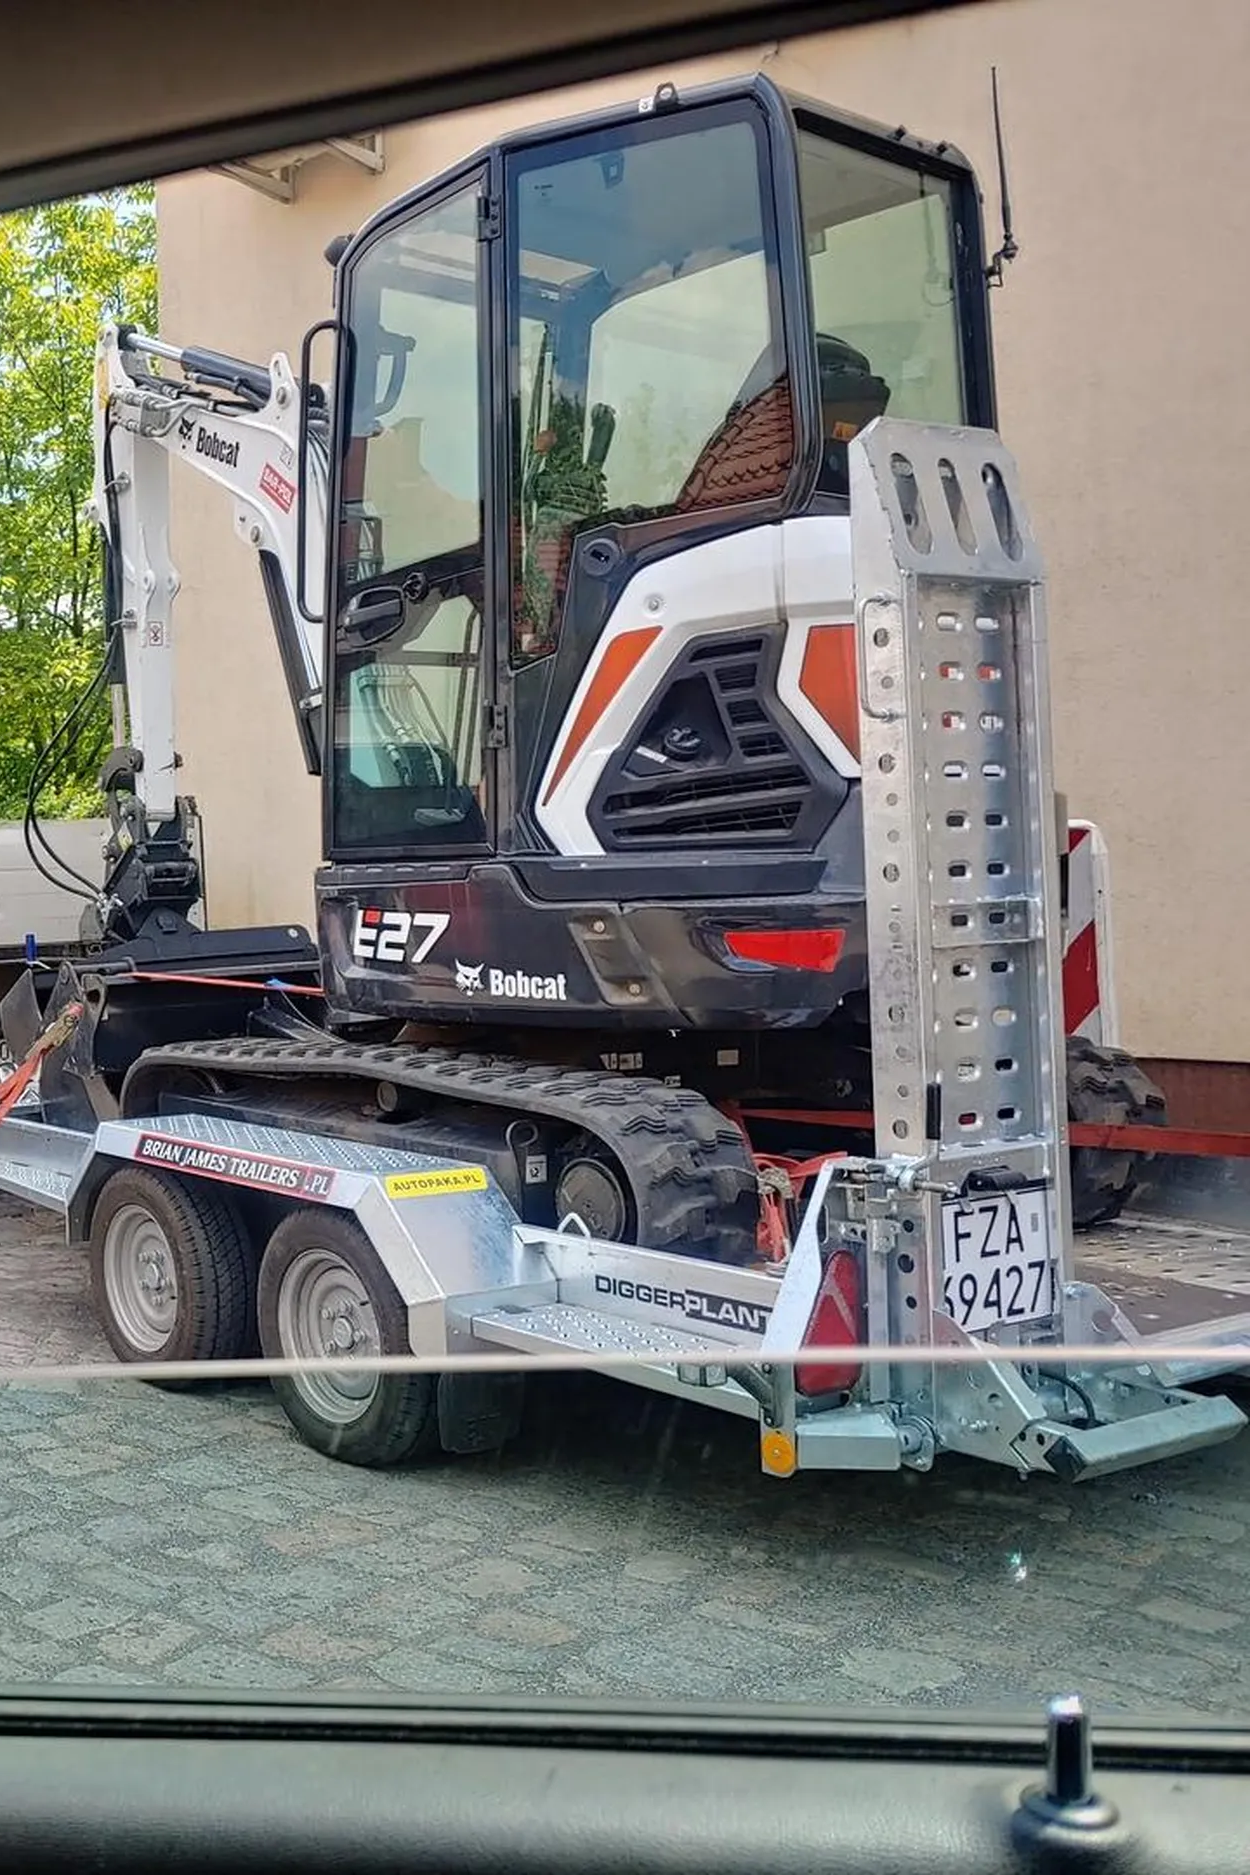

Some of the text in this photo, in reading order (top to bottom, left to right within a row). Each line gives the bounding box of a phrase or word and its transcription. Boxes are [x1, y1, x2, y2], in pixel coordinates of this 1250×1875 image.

[196, 426, 240, 468] Bobcat
[353, 909, 451, 964] E27
[488, 968, 567, 1000] Bobcat
[142, 1139, 183, 1162] BRIAN
[180, 1148, 229, 1173] JAMES
[229, 1157, 300, 1188] TRAILERS
[393, 1174, 482, 1192] AUTOPAKA.PL
[954, 1202, 1025, 1263] FZA
